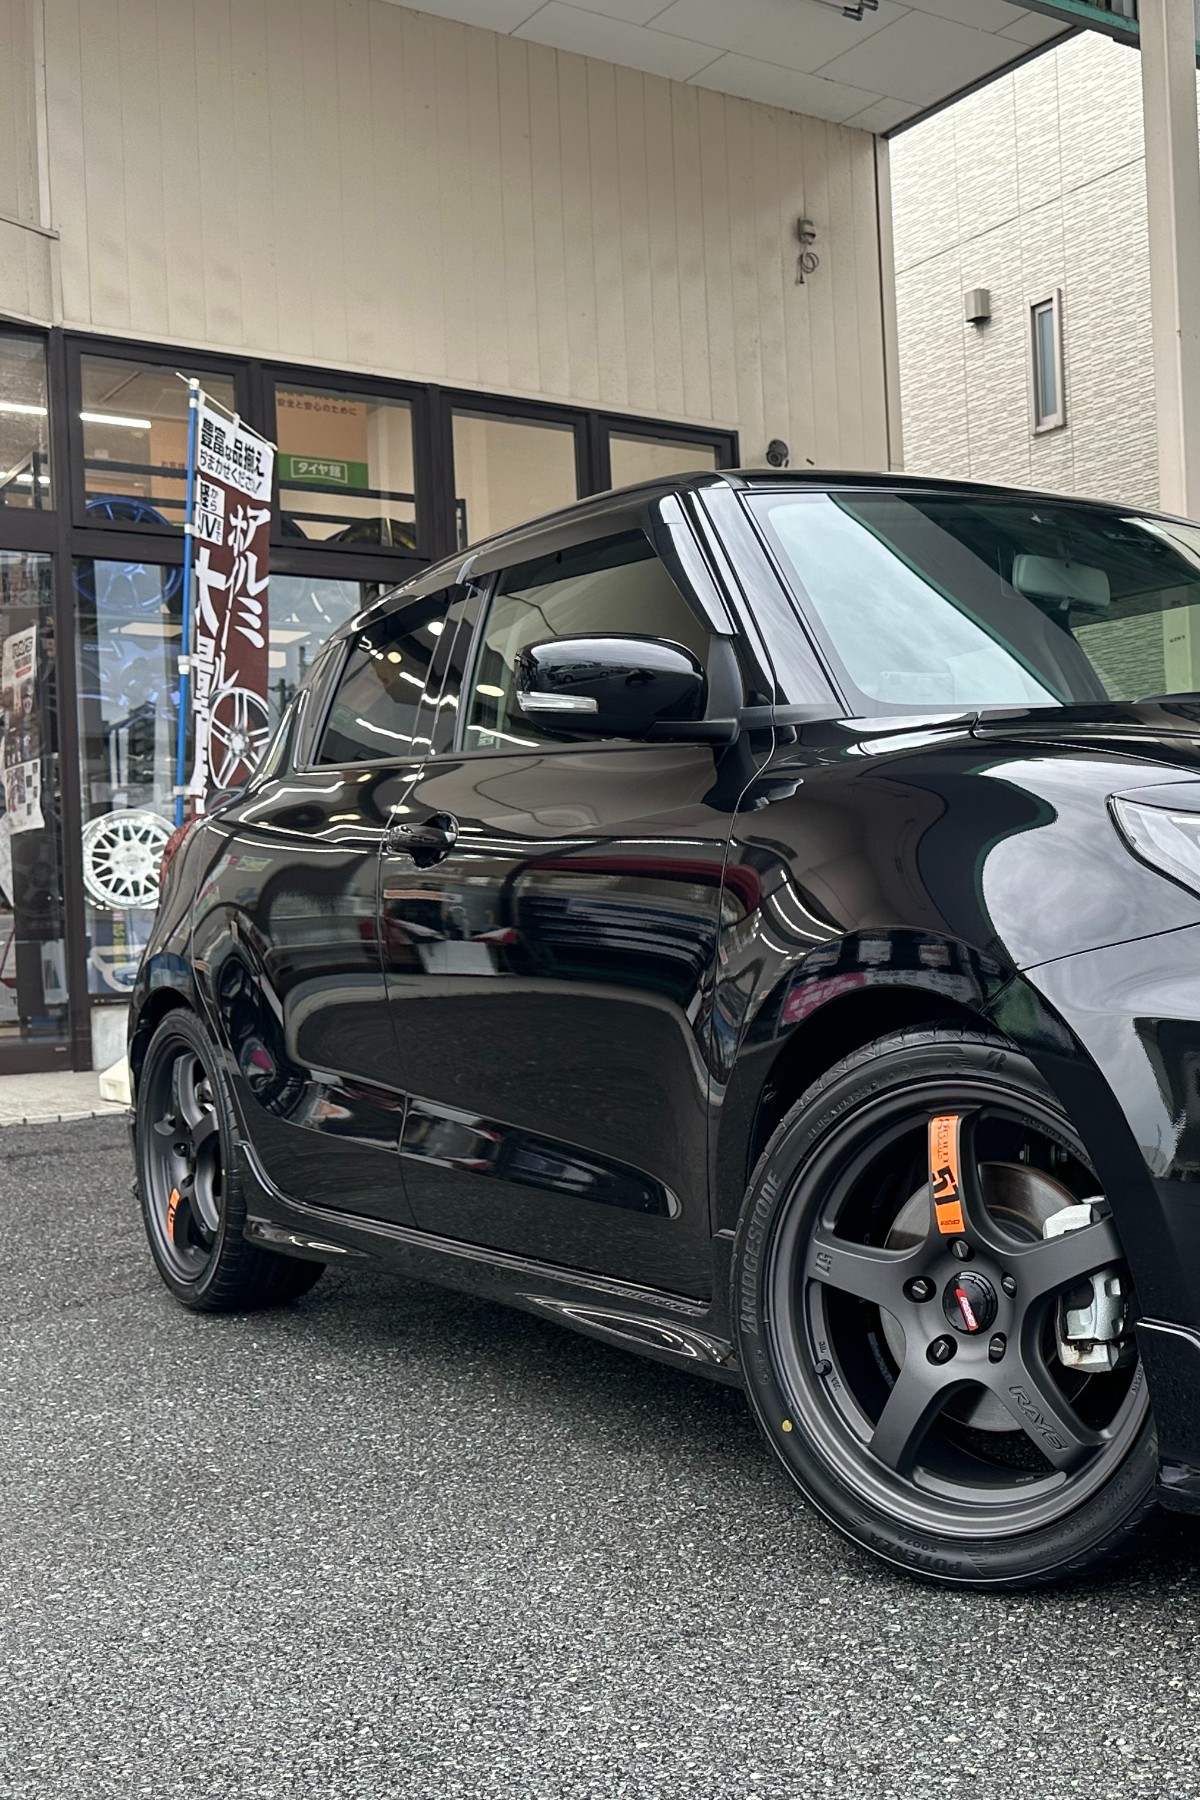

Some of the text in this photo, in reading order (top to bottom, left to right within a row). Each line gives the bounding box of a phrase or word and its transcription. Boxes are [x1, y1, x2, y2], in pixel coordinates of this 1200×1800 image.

[201, 418, 265, 477] 豊富な品揃え
[298, 462, 342, 478] タイヤ館
[741, 1169, 781, 1335] BRIDGESTONE
[1008, 1385, 1069, 1450] RAYS
[870, 1532, 963, 1574] POTENZA
[899, 1535, 938, 1553] S007A
